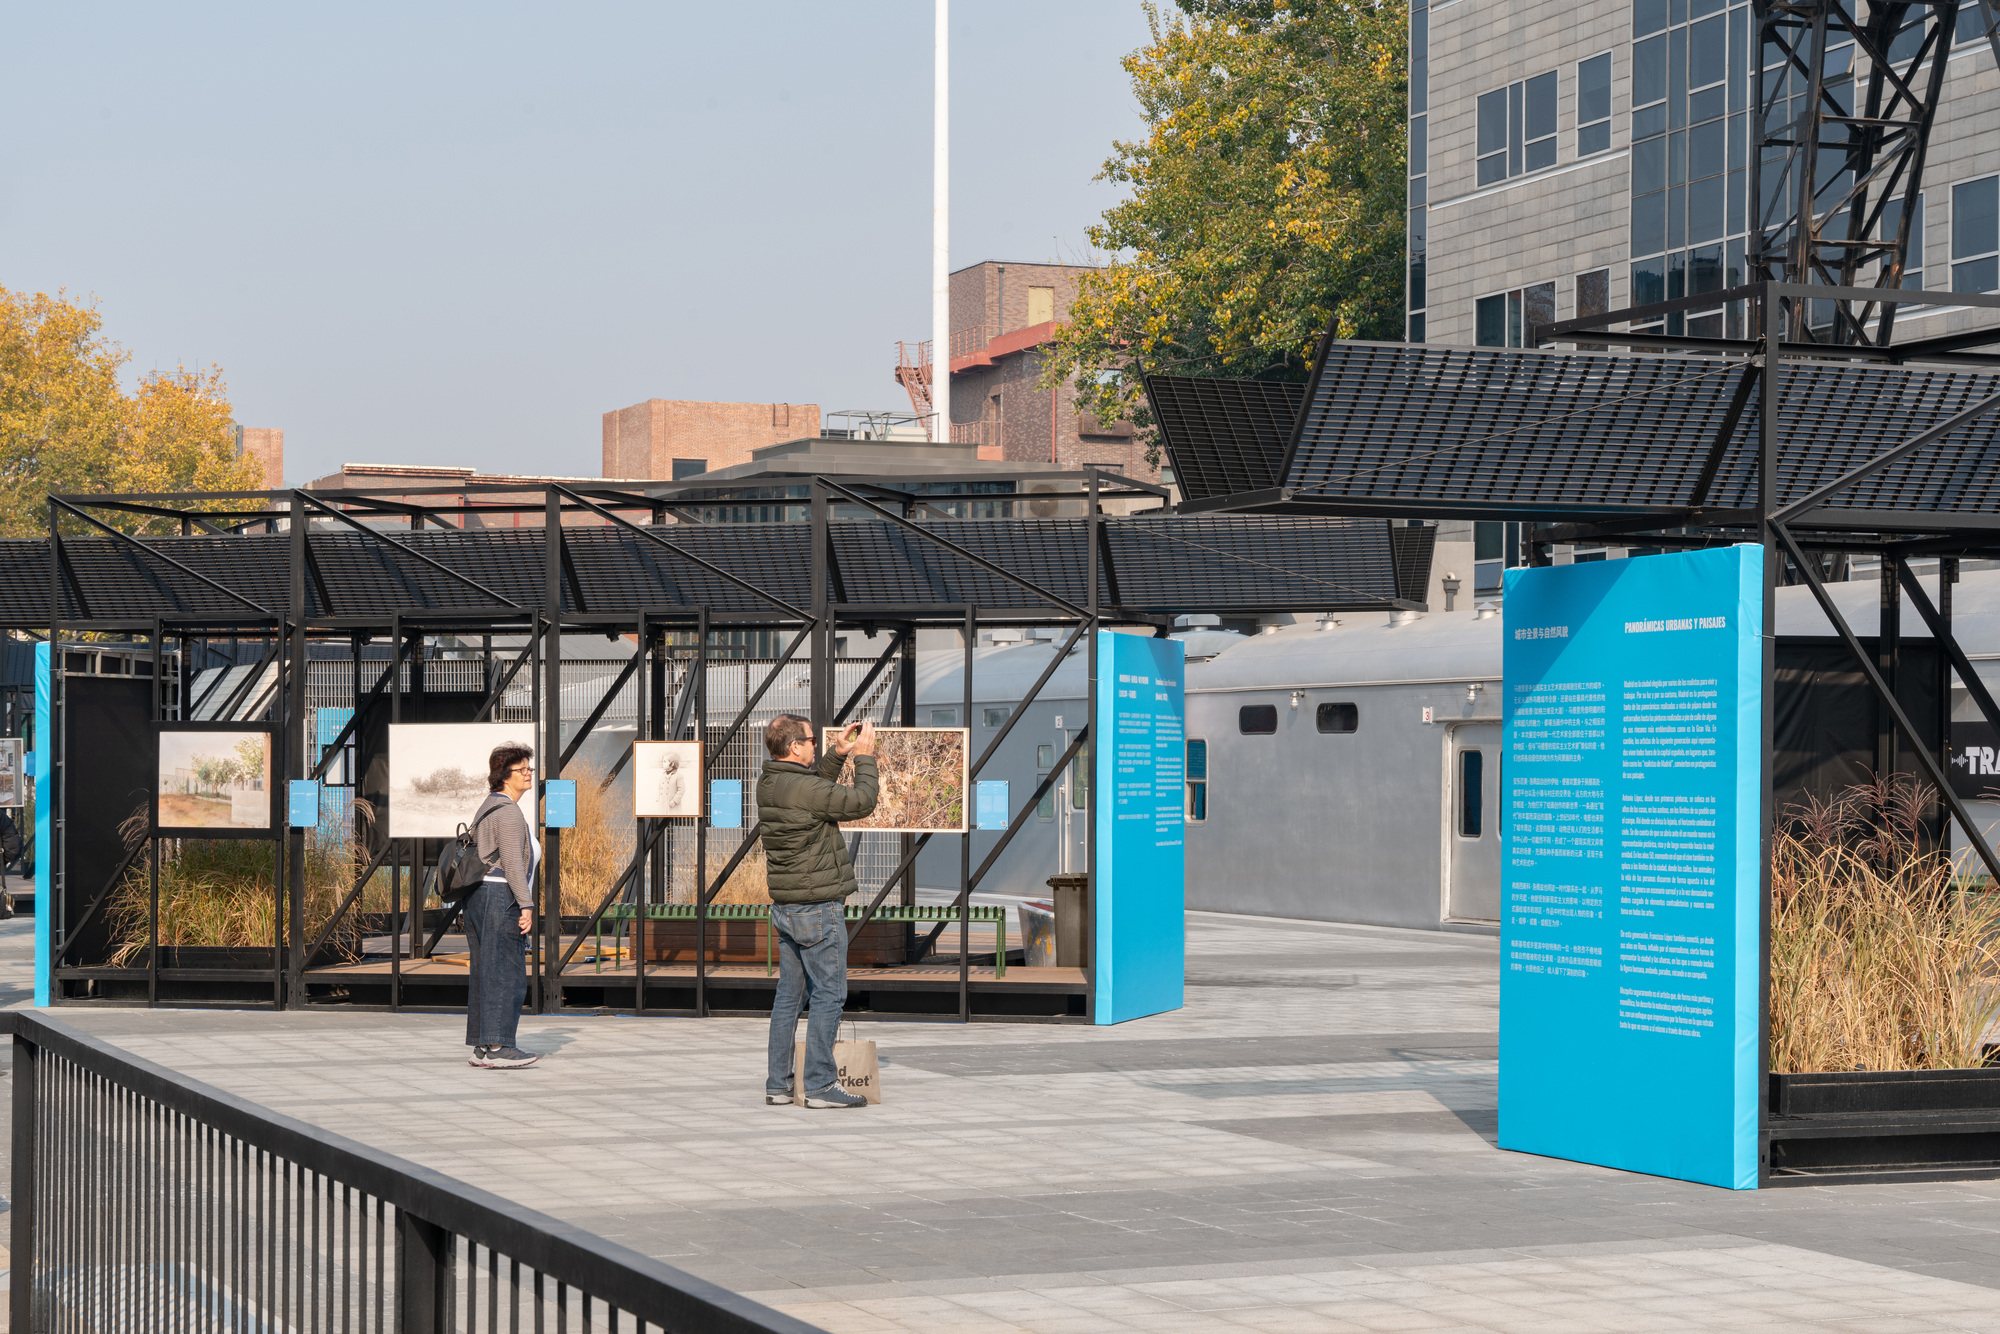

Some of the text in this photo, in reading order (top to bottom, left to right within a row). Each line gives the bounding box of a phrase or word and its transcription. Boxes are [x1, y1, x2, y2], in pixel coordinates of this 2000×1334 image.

[1625, 616, 1726, 633] PANORÁMICAS URBANAS Y PAISAJES
[1515, 625, 1568, 640] 城市全景与自然风貌
[837, 1075, 869, 1087] rket
